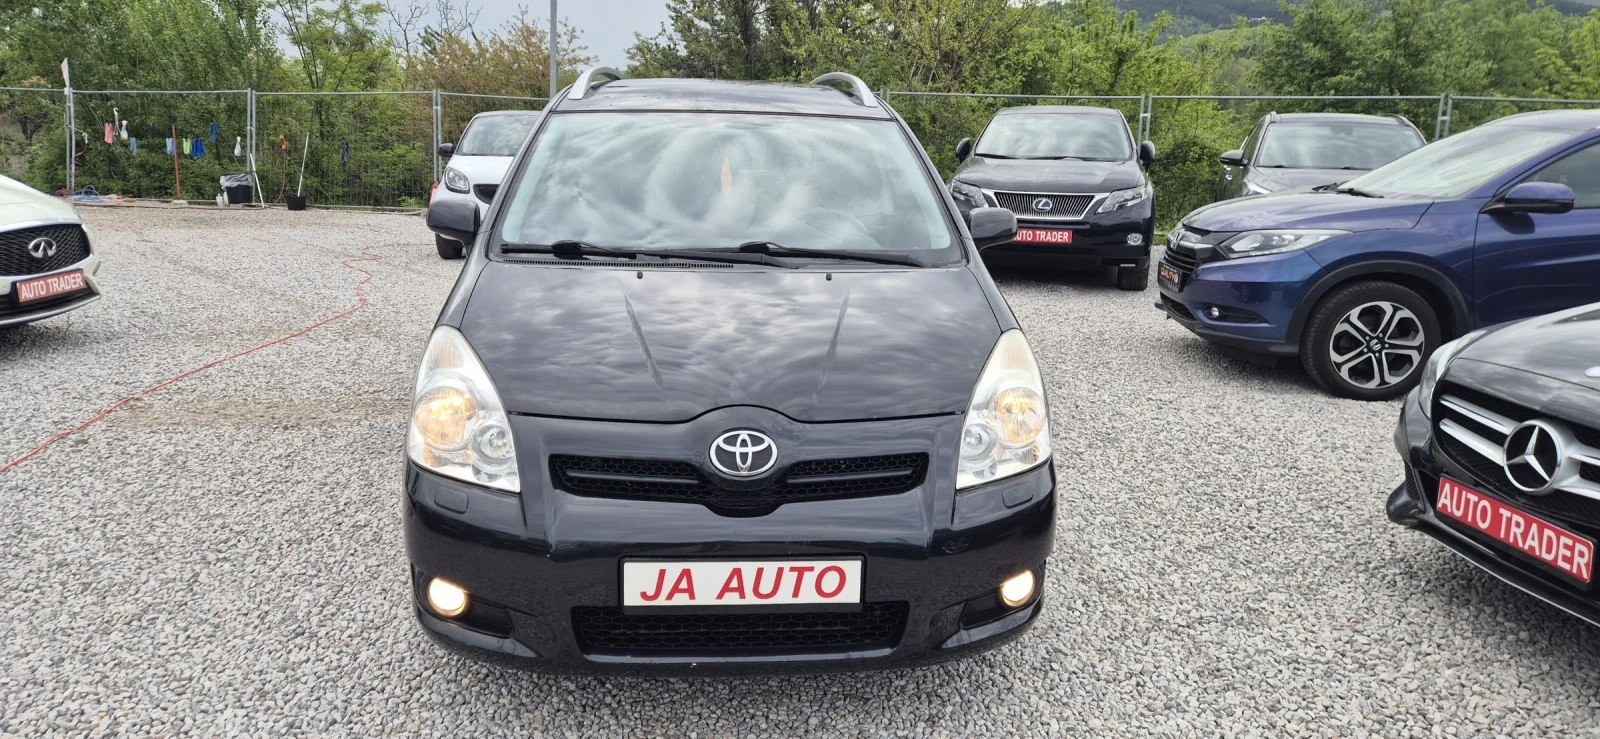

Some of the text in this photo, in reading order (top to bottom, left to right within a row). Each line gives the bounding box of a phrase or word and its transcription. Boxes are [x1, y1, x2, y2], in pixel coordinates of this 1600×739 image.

[1016, 230, 1069, 242] UTO TRADER
[21, 273, 83, 300] AUTO TRADER
[1438, 482, 1590, 580] AUTO TRADER
[640, 566, 847, 601] JA AUTO
